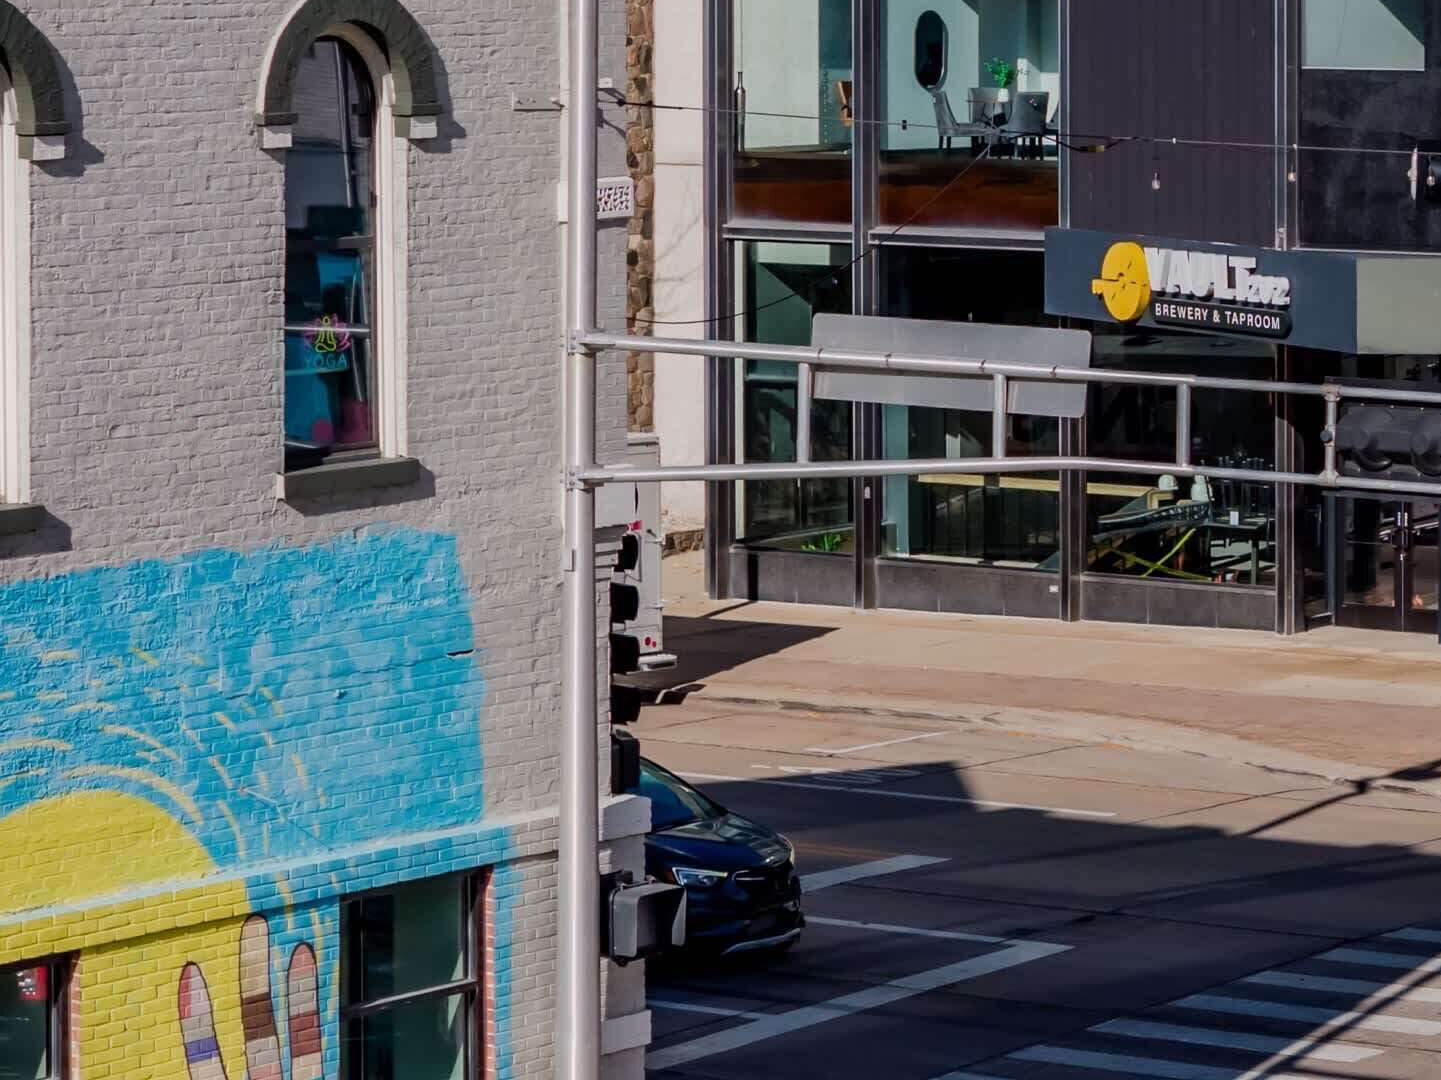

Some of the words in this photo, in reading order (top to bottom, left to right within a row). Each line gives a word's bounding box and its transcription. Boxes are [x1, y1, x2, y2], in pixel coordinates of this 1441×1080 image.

[1143, 247, 1257, 301] VAULT
[1155, 303, 1208, 321] BREWERY
[1212, 309, 1221, 323] &
[1224, 310, 1281, 330] TAPROOM
[304, 353, 347, 369] YOGA
